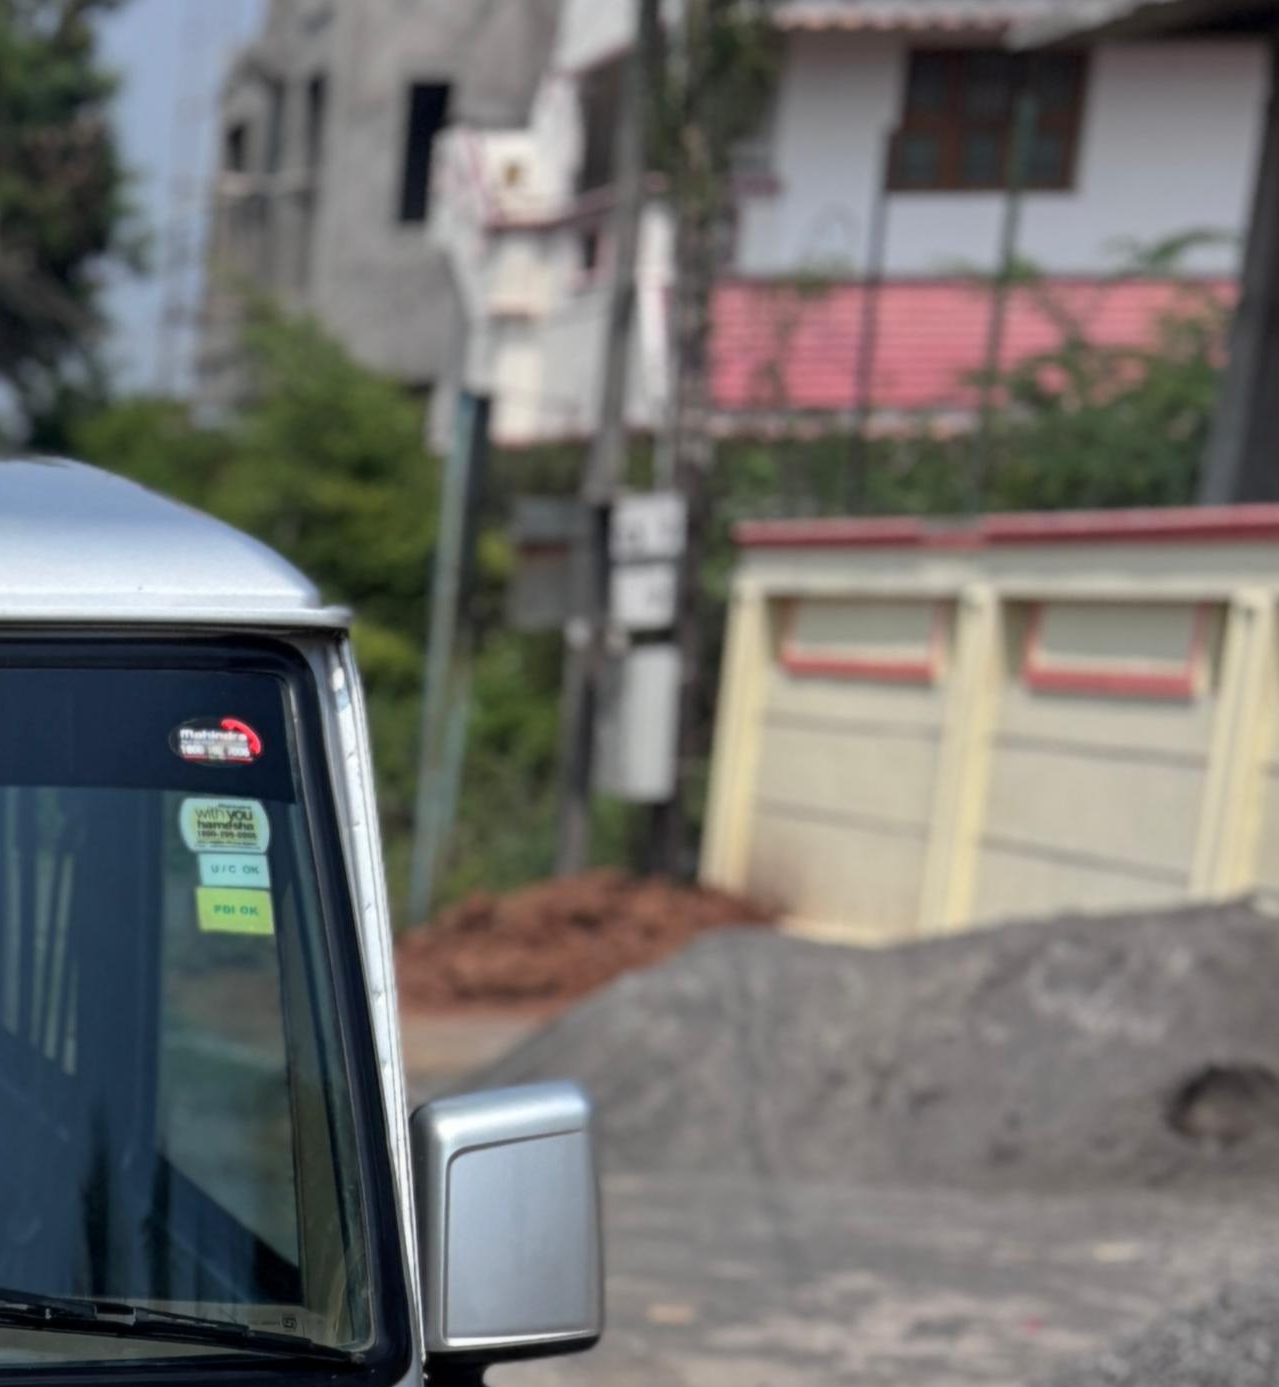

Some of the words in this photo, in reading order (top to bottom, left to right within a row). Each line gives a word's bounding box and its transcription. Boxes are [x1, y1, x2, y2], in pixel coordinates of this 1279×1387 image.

[195, 807, 225, 819] with
[227, 809, 253, 826] you
[240, 905, 259, 917] OK
